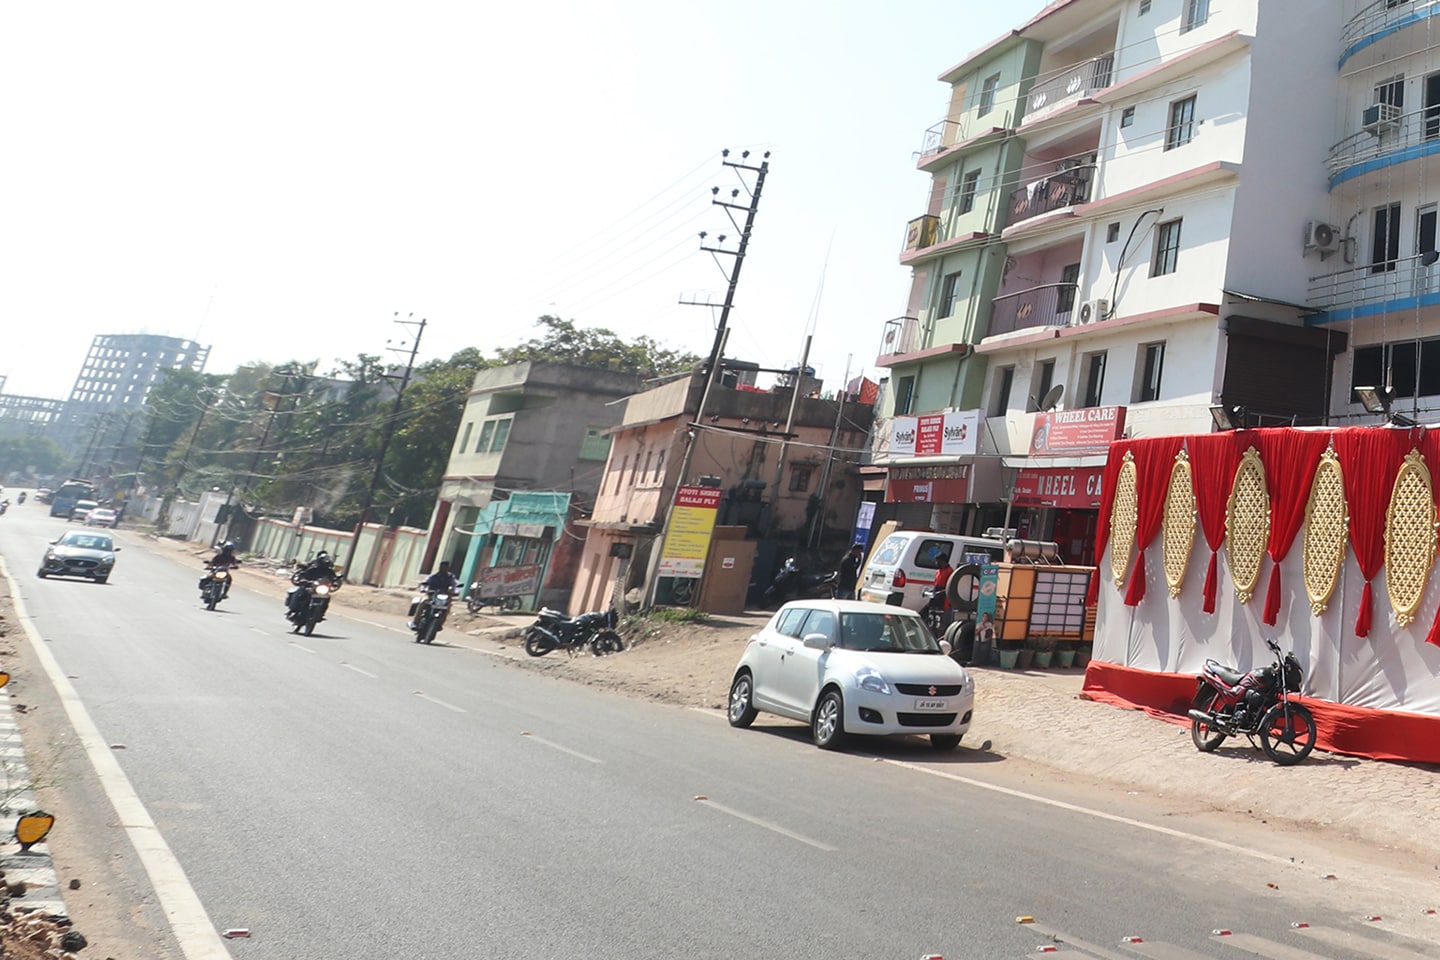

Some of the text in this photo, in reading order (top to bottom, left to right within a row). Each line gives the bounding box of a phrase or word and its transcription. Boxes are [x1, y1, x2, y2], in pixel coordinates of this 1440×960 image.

[1055, 408, 1116, 423] WHEEL CARE
[1038, 475, 1076, 495] WHEEL
